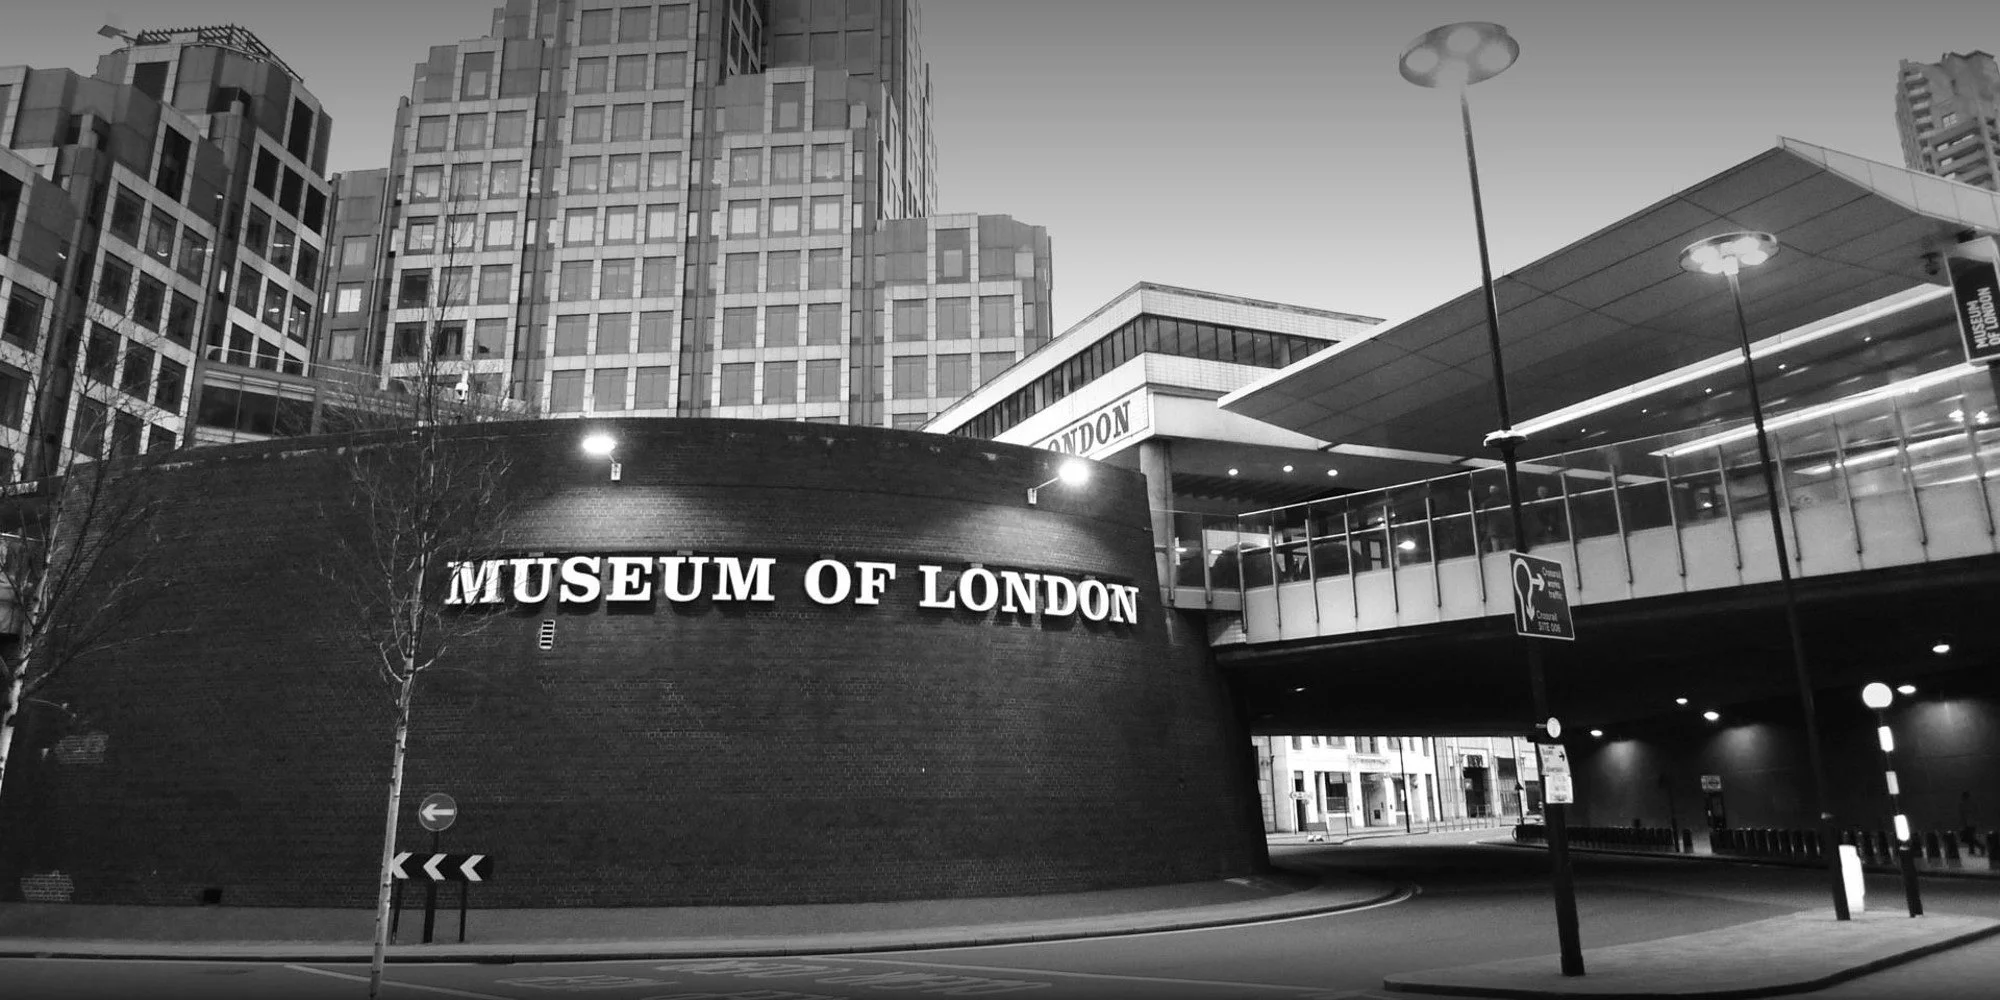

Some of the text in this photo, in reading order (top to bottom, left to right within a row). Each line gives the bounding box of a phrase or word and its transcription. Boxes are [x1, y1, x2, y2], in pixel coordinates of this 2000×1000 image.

[1966, 300, 1989, 348] MUSEUM
[1976, 287, 2000, 346] OF LONDON
[445, 556, 1139, 625] MUSEUM OF LONDON
